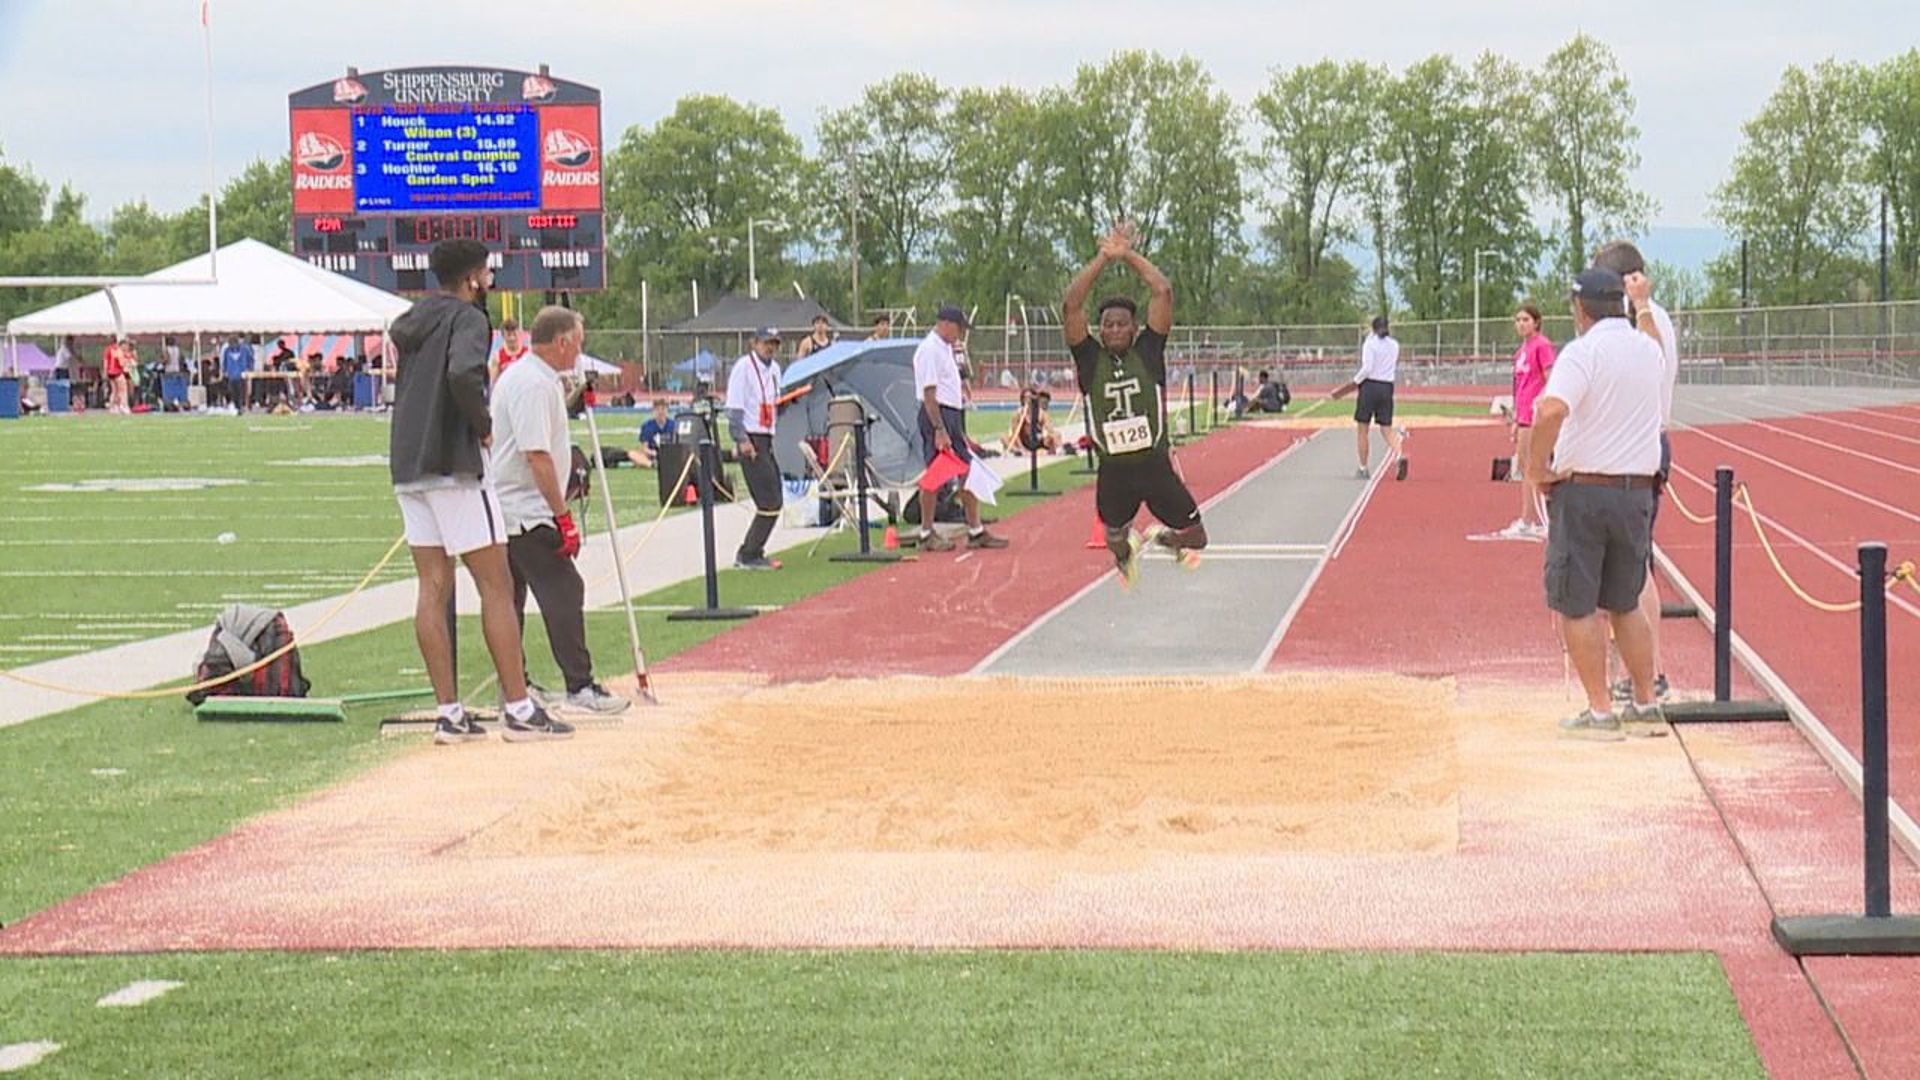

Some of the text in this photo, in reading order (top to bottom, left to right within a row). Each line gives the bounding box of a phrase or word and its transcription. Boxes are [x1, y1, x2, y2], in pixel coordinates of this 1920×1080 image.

[383, 72, 504, 90] SHIPPENSBURG
[394, 87, 493, 103] UNIVERSITY
[358, 116, 364, 127] 1
[382, 115, 426, 127] Houck
[404, 127, 452, 138] Wilson
[357, 140, 366, 152] 2
[383, 140, 430, 151] Turner
[406, 150, 520, 162] Central Dauphin
[357, 163, 366, 175] 3
[296, 172, 352, 190] RAIDERS
[407, 173, 494, 187] Garden Spot
[543, 169, 599, 187] RAIDERS
[1109, 425, 1148, 445] 1128
